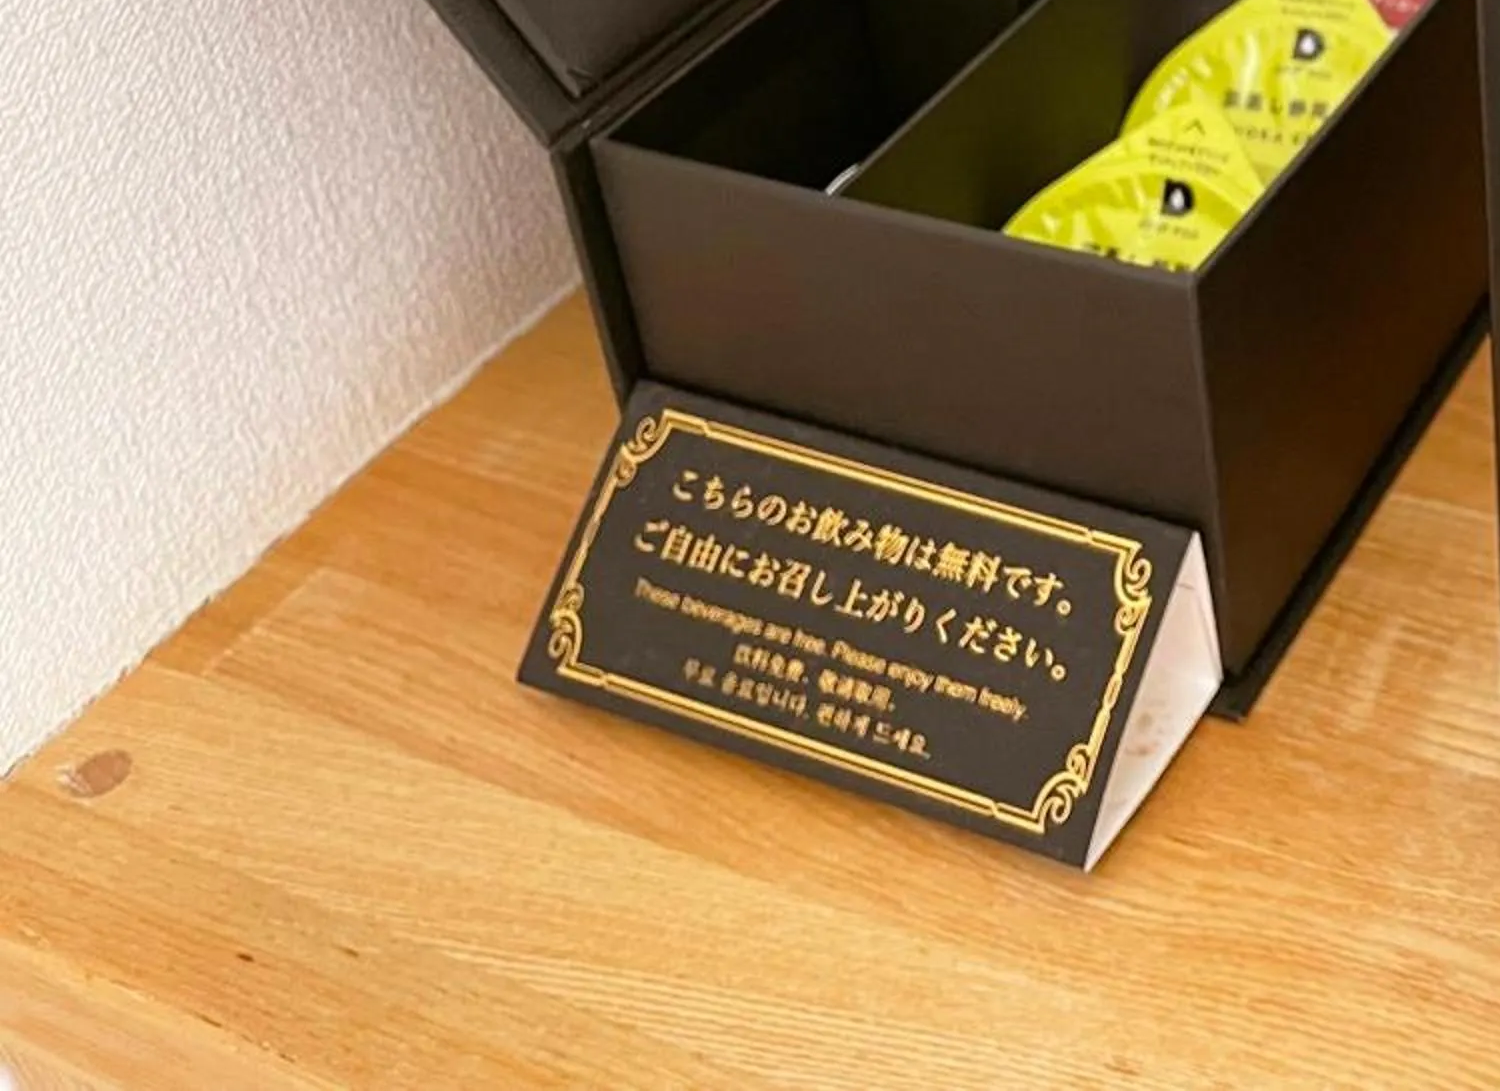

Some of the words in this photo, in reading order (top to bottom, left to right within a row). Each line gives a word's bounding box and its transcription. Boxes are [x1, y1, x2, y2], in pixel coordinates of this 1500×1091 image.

[634, 520, 1066, 682] ご自由にお召し上がりください。
[673, 470, 1072, 616] こちらのお飲み物は無料です。
